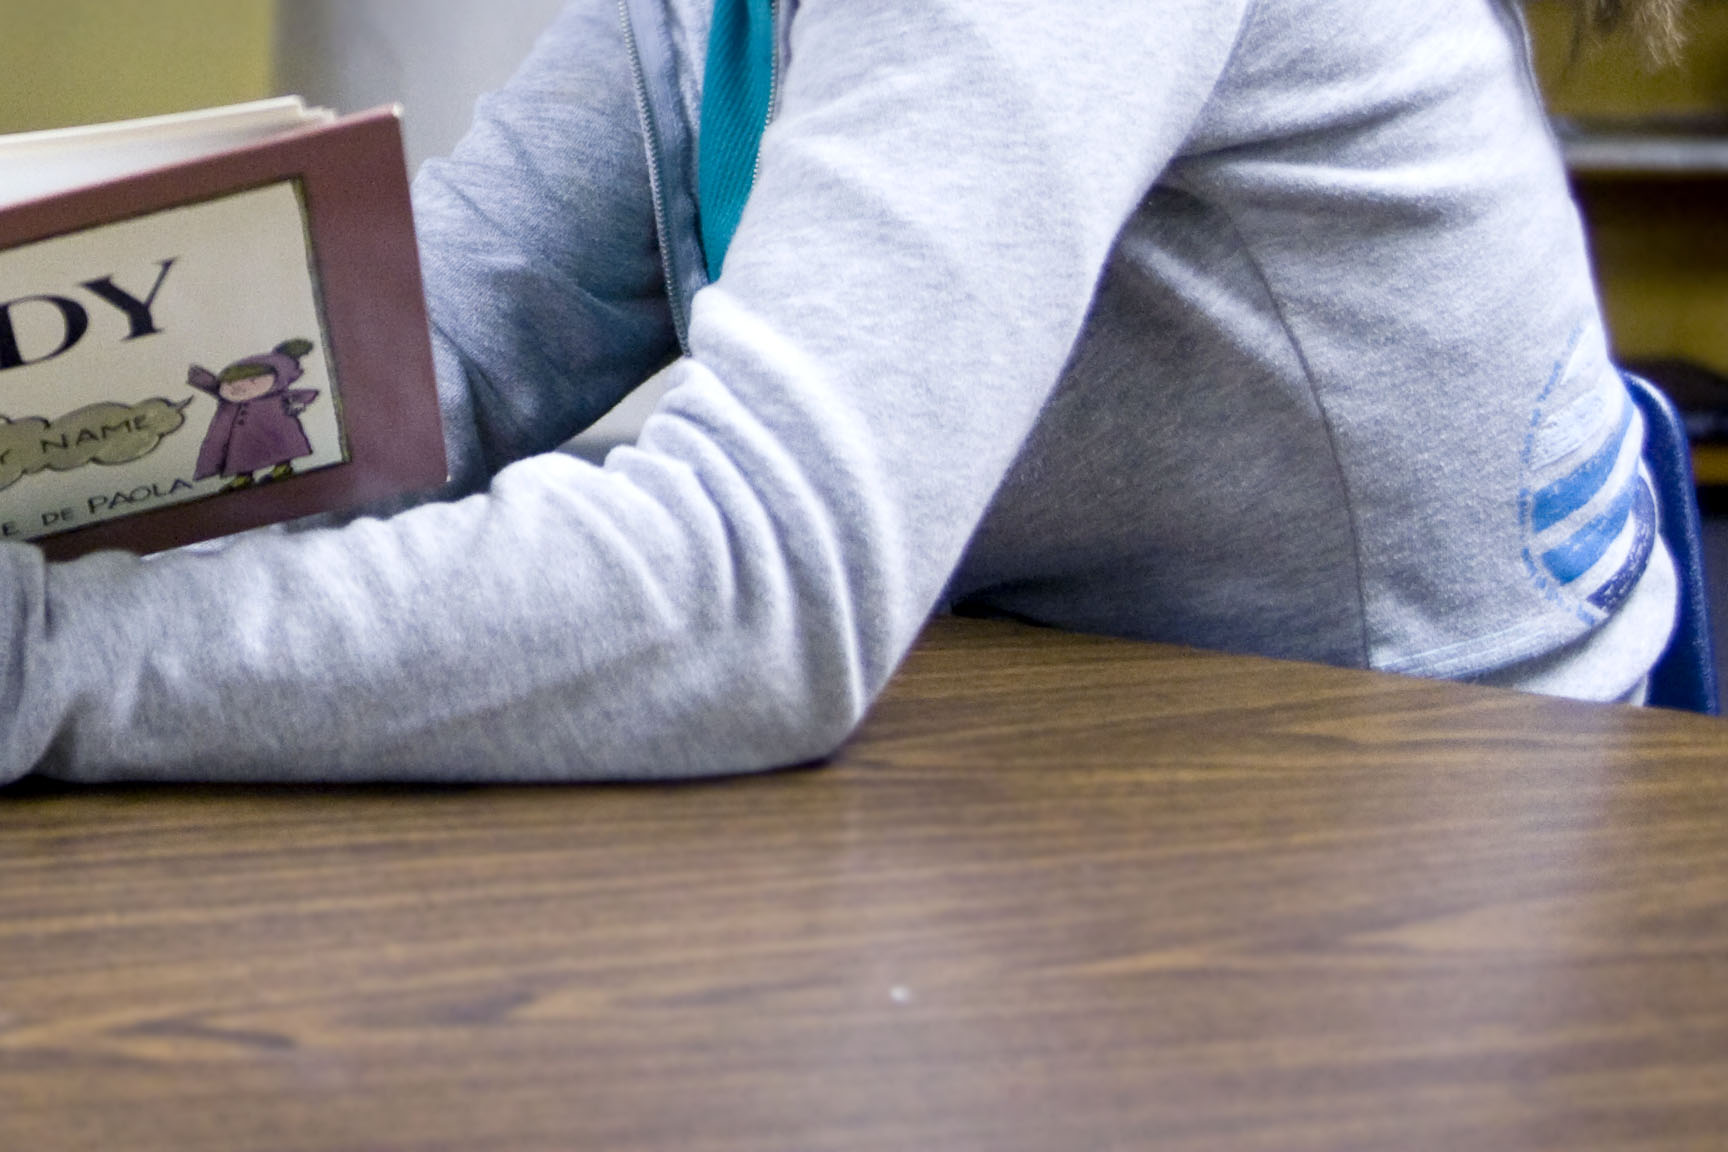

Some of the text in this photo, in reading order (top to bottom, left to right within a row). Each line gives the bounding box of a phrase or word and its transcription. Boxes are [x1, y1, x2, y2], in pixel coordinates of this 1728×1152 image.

[39, 412, 155, 453] NAME
[41, 507, 74, 527] DE
[87, 478, 194, 515] PAOLA
